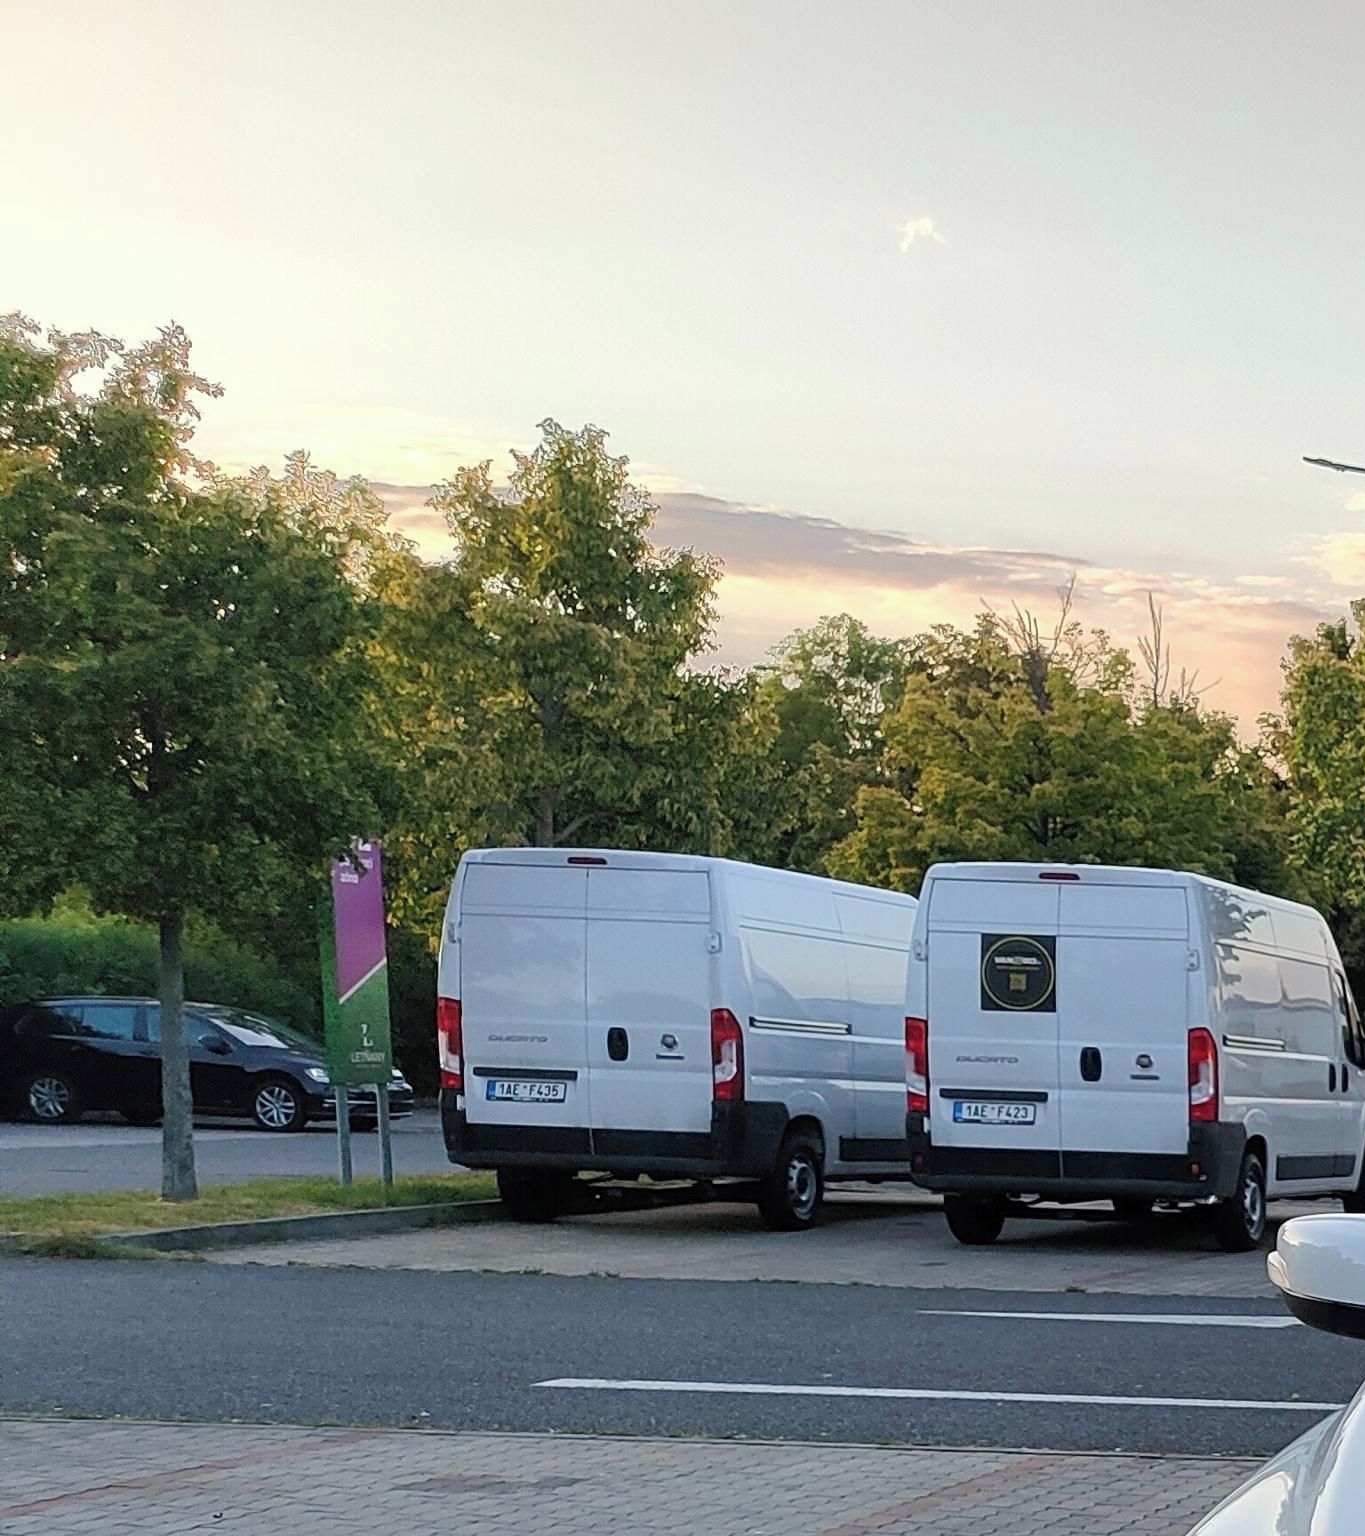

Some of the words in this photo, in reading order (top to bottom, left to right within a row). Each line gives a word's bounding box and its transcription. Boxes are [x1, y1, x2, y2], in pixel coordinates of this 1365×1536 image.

[499, 1083, 520, 1096] 1AE
[528, 1084, 559, 1097] F435
[966, 1105, 988, 1118] 1AE
[997, 1106, 1029, 1119] F423
